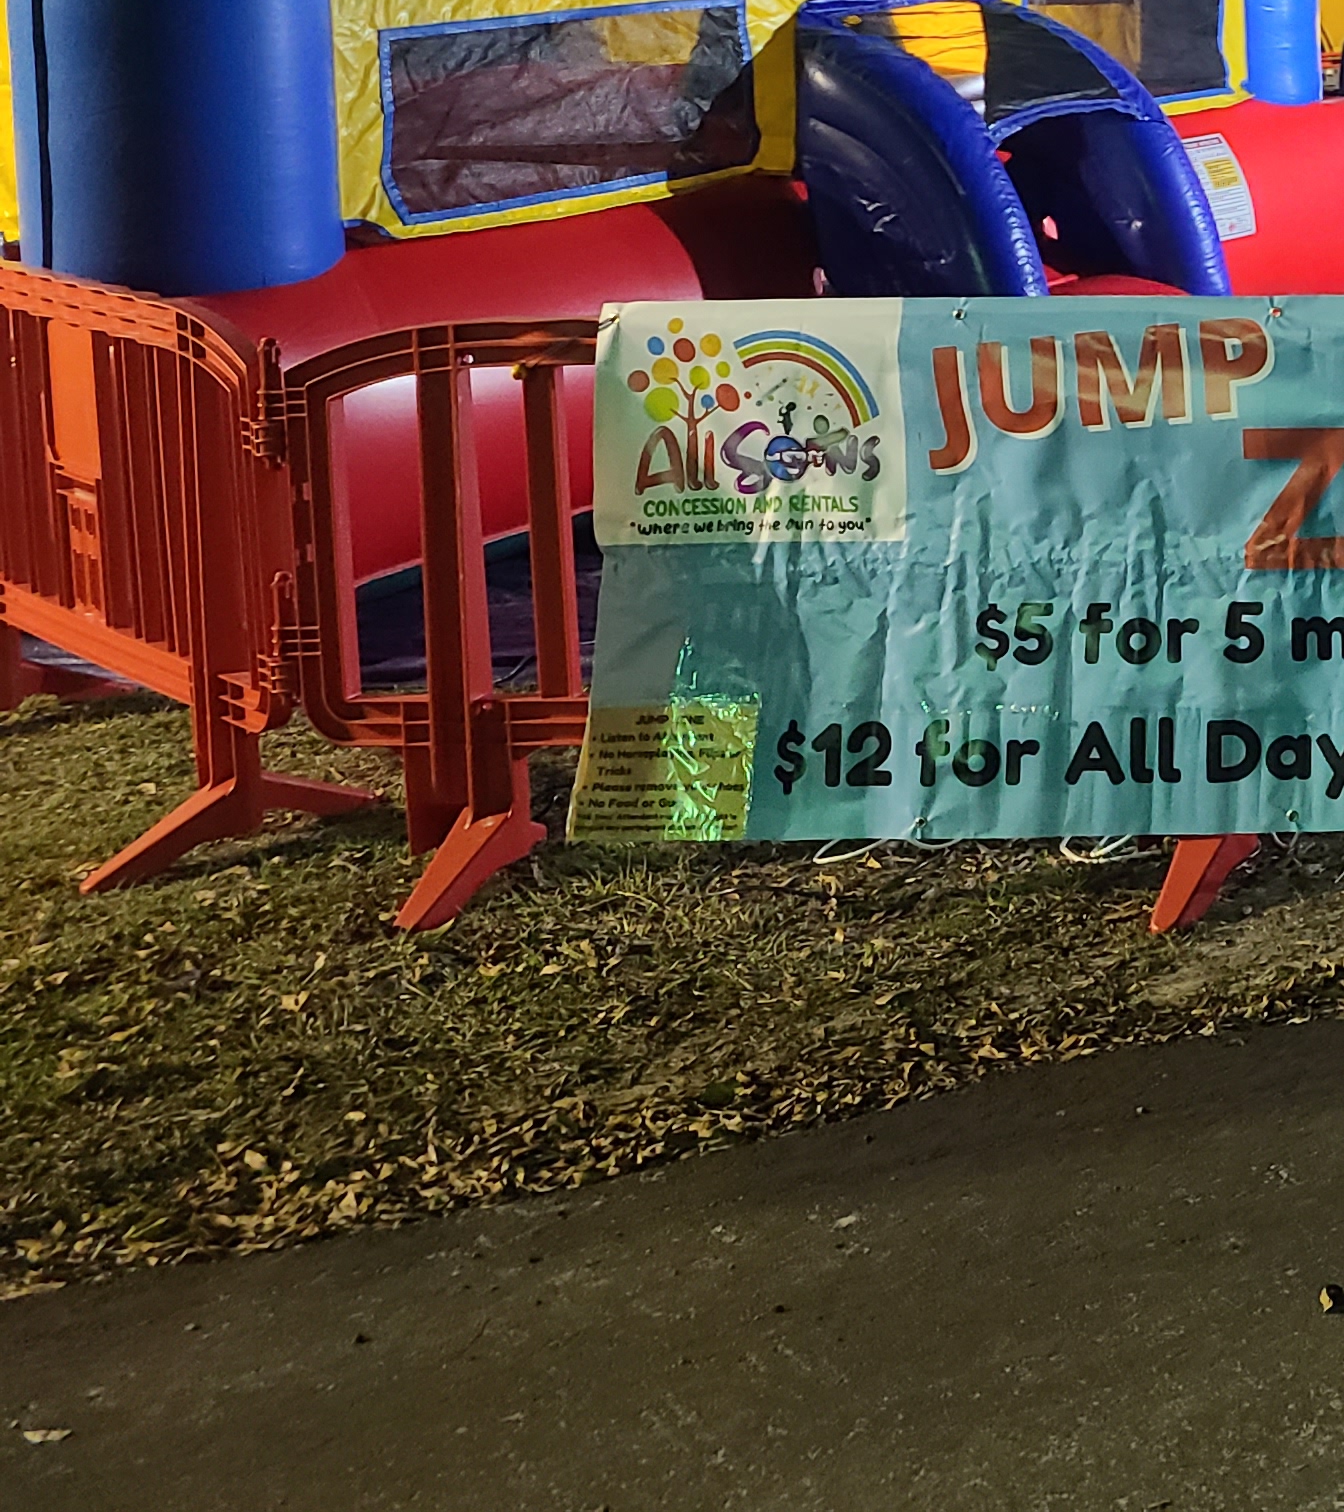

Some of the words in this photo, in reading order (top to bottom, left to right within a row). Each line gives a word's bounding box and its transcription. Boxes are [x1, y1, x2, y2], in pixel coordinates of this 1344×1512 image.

[928, 317, 1275, 475] JUMP
[643, 497, 746, 517] CONCESSION
[753, 495, 783, 514] AND
[789, 494, 859, 513] RENTALS
[693, 521, 713, 534] we
[717, 519, 754, 536] bring
[818, 518, 834, 532] to
[975, 602, 1055, 671] $5
[1080, 602, 1199, 665] for
[1222, 601, 1264, 664] 5
[636, 714, 670, 726] JUMP
[600, 732, 635, 743] Listen
[639, 732, 650, 742] to
[774, 719, 893, 794] $12
[916, 719, 1040, 787] for
[1064, 719, 1181, 786] All
[592, 781, 632, 792] Please
[588, 797, 605, 808] No
[608, 796, 639, 808] Food
[641, 799, 655, 808] or
